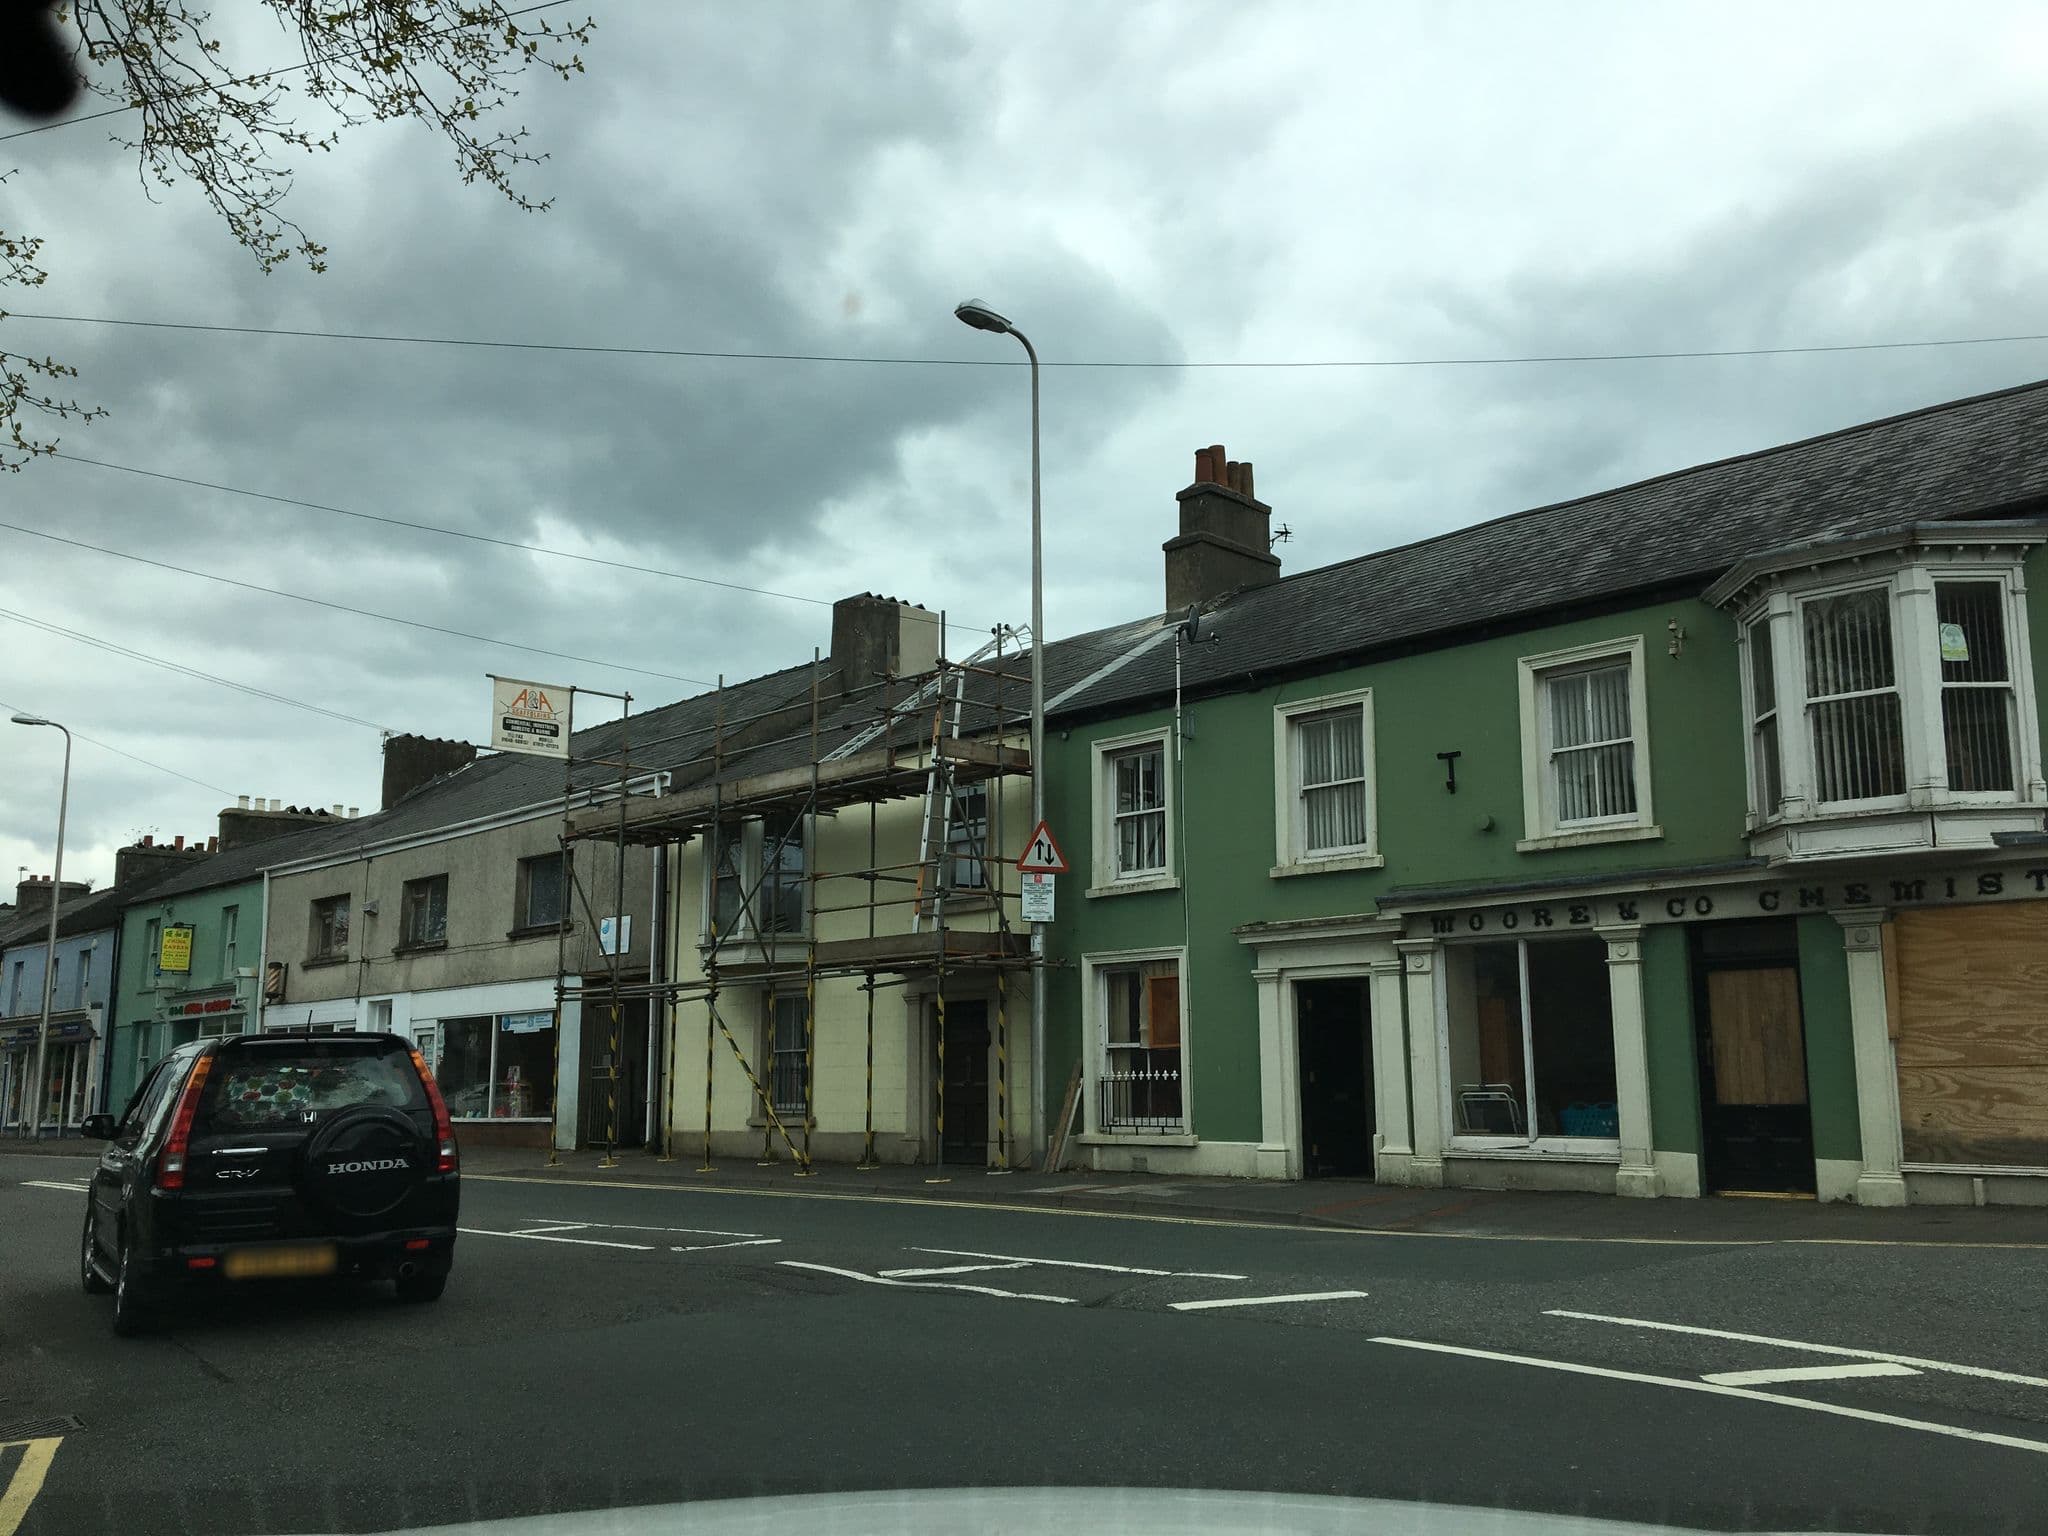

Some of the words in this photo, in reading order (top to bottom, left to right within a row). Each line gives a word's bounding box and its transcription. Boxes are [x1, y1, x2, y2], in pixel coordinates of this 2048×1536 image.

[511, 688, 553, 713] A&A
[1430, 905, 1590, 934] MOORE
[1666, 894, 1713, 918] CO
[216, 1169, 260, 1178] CR-V
[328, 1159, 409, 1175] HONDA
